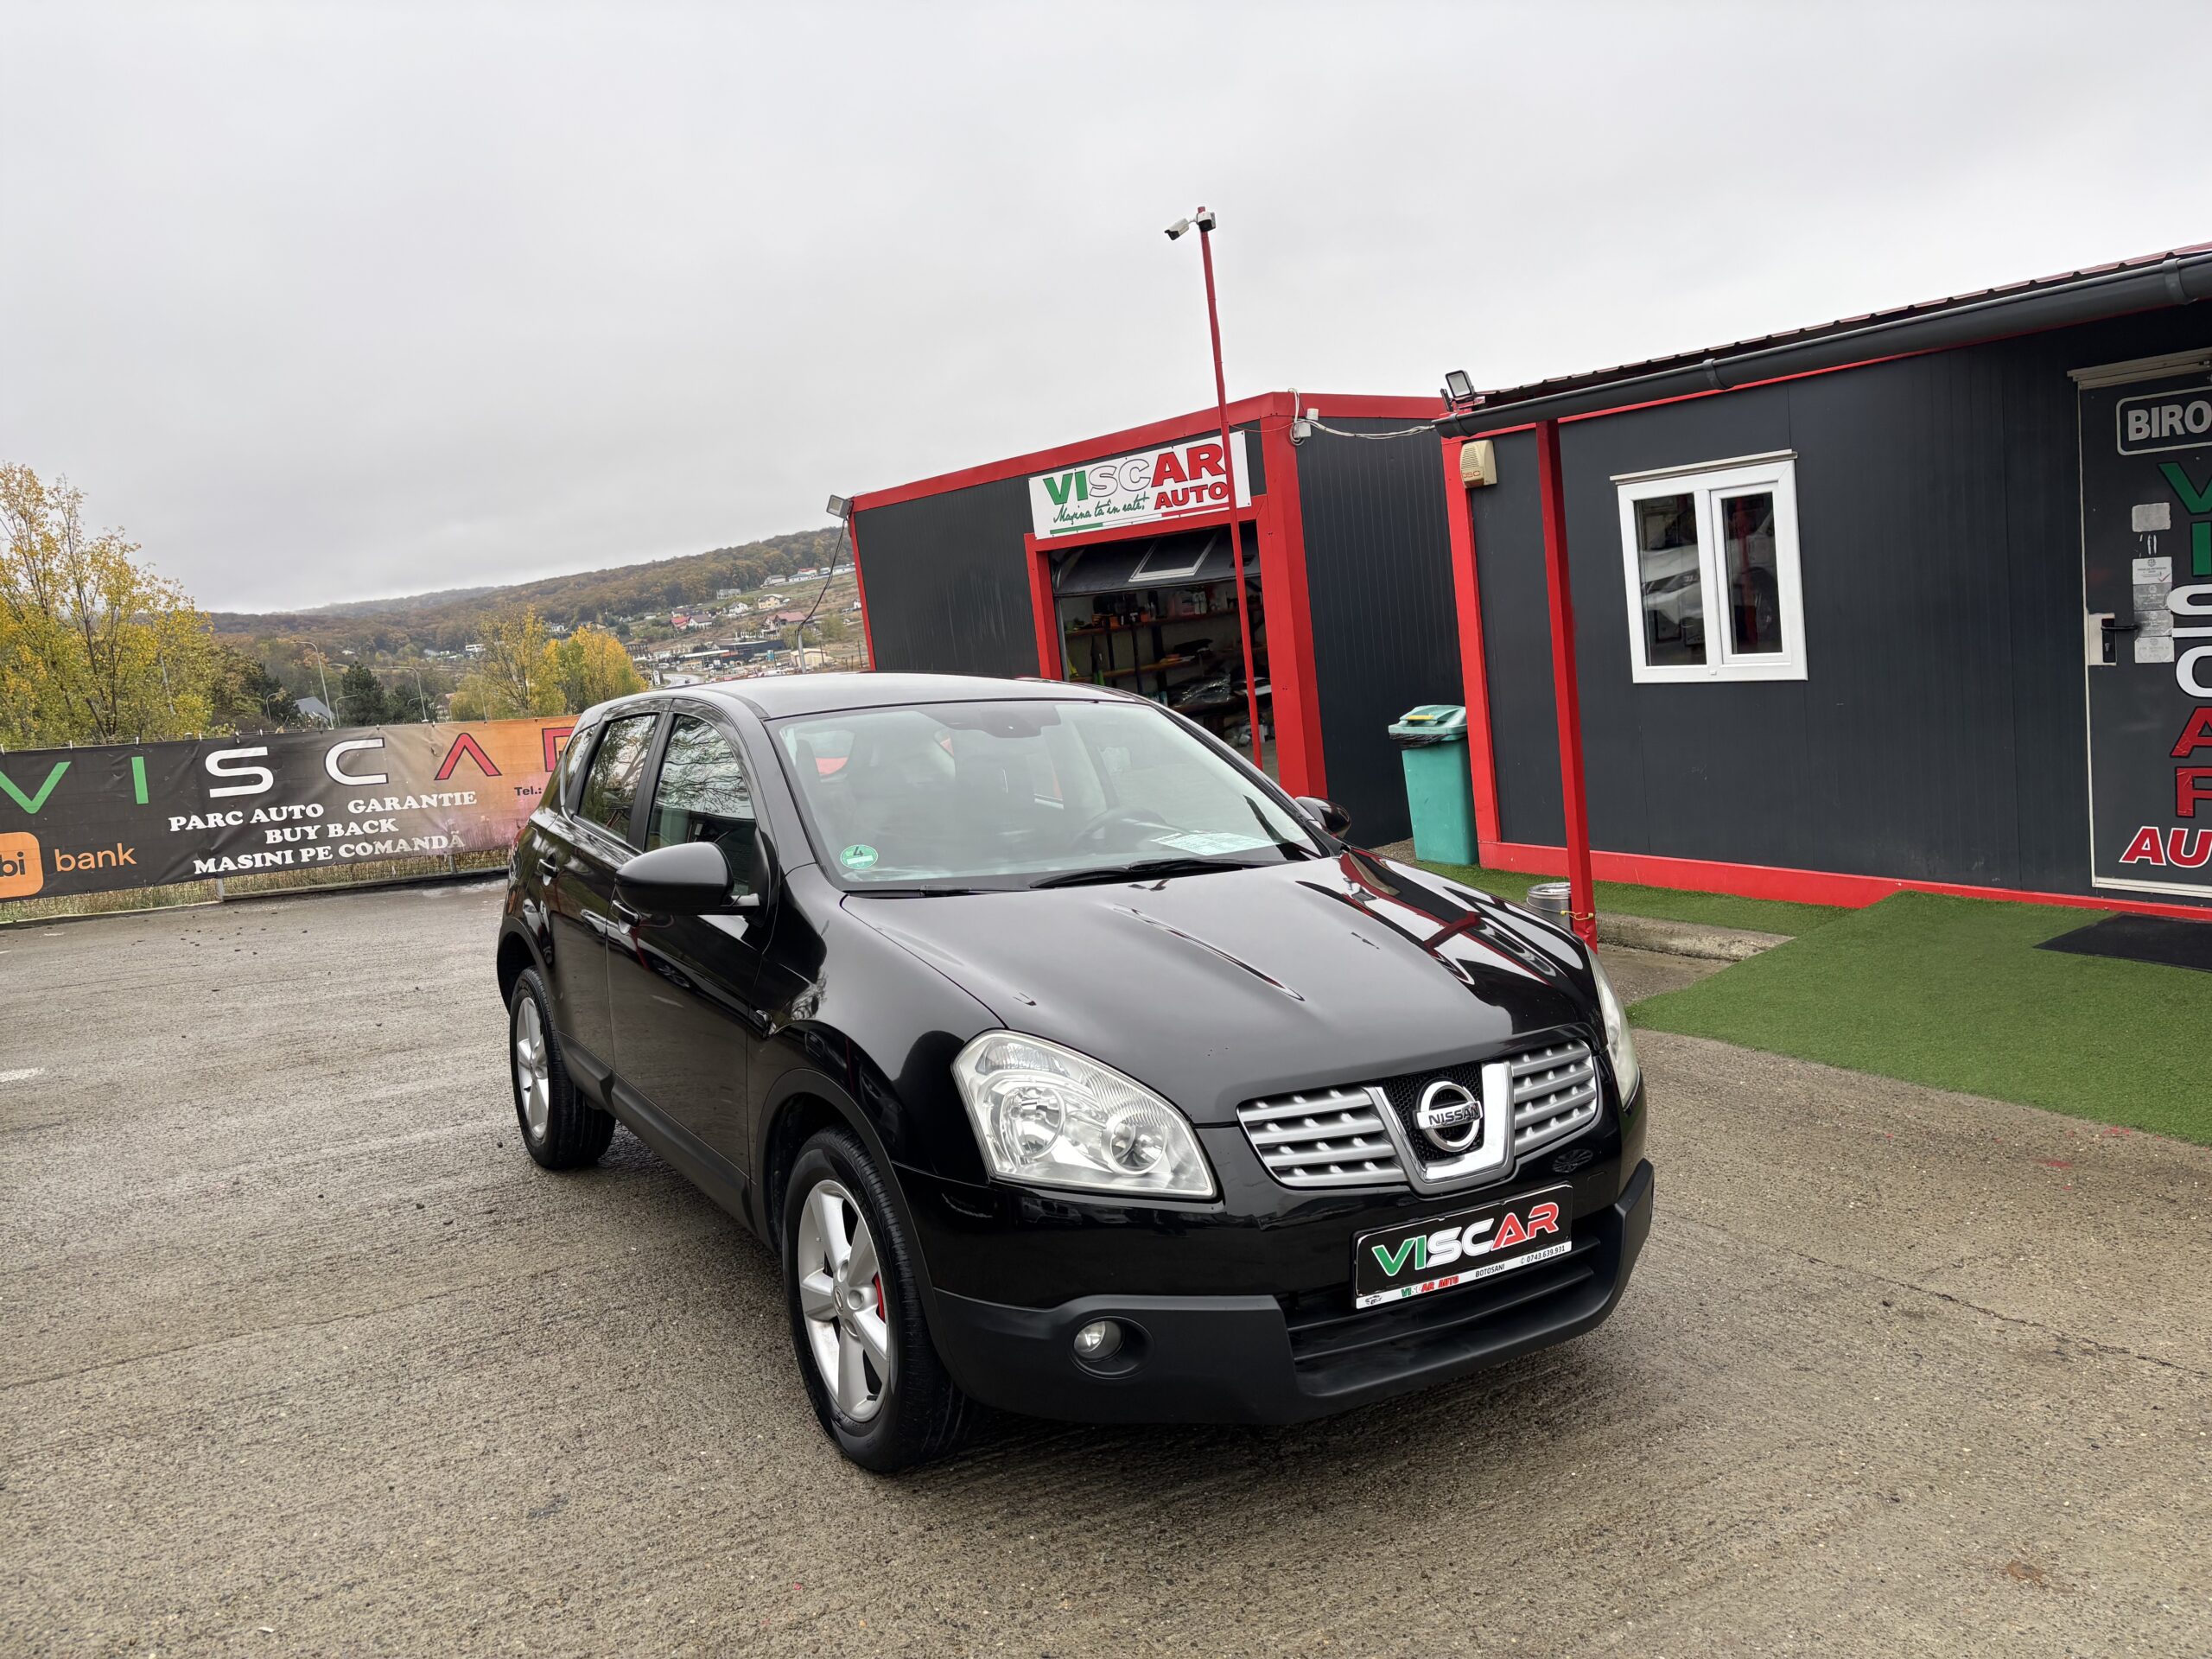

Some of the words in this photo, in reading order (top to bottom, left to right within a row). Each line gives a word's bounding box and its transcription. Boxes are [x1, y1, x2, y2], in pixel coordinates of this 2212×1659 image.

[1043, 443, 1226, 505] VISCAR
[1154, 482, 1229, 510] AUTO
[168, 810, 244, 832] PARC
[250, 804, 325, 823] AUTO
[347, 791, 477, 814] GARANTIE
[264, 824, 321, 844] BUY
[327, 818, 399, 838] BACK
[54, 842, 137, 873] bank
[193, 849, 294, 874] MASINI
[299, 846, 334, 862] PE
[853, 846, 864, 856] 4
[1428, 1102, 1480, 1126] NISSAN
[1372, 1202, 1560, 1277] VISCAR
[1401, 1281, 1435, 1297] VISCAR
[1438, 1275, 1459, 1288] AUTO
[1475, 1263, 1505, 1278] BOTOSANI
